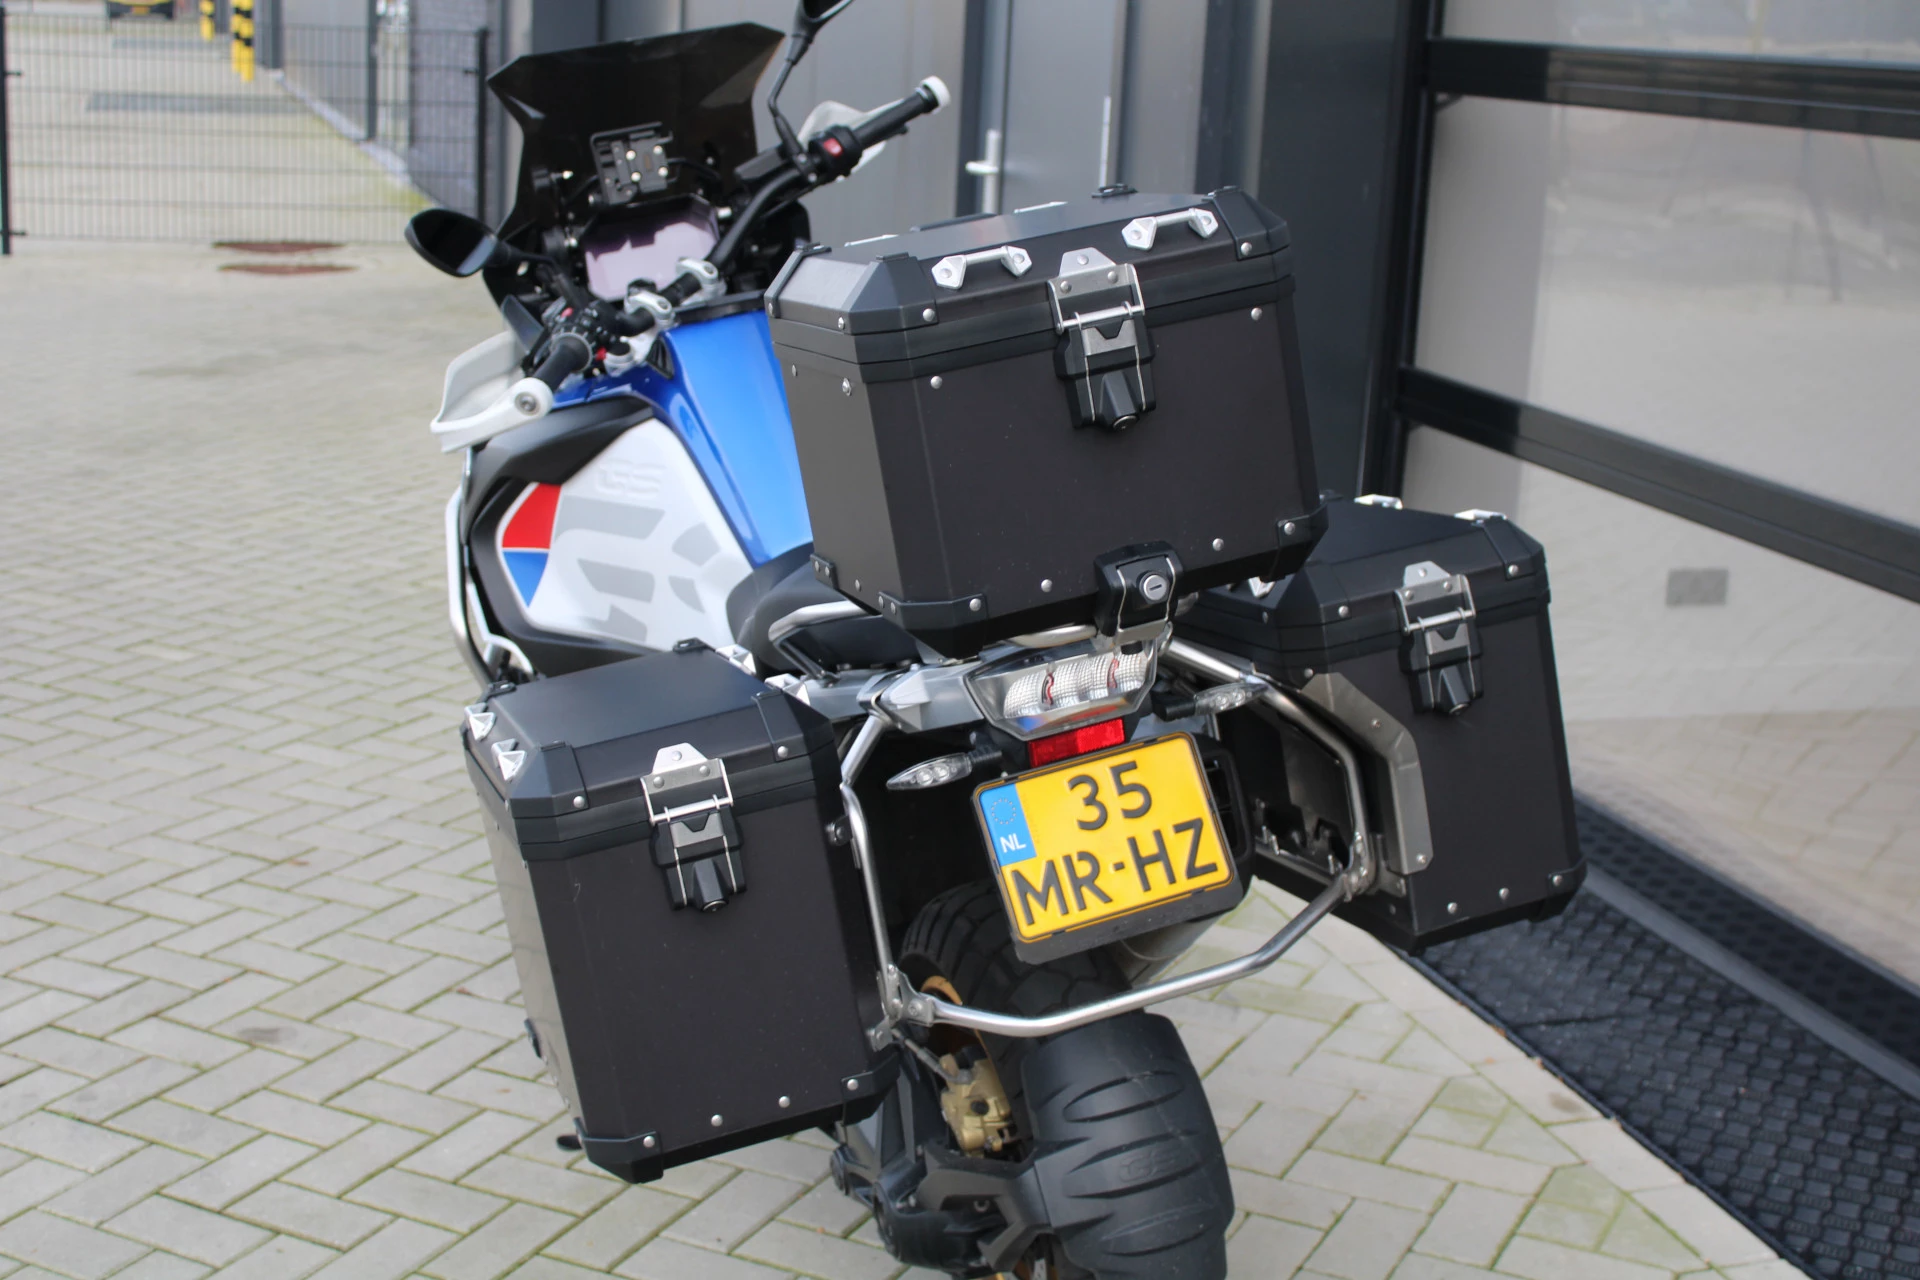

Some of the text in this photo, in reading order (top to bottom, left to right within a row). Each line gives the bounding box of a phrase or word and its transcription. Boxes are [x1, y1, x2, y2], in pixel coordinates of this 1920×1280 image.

[596, 457, 667, 498] GS
[1067, 760, 1153, 831] 35
[1000, 832, 1027, 853] NL
[1011, 817, 1219, 926] MR-HZ
